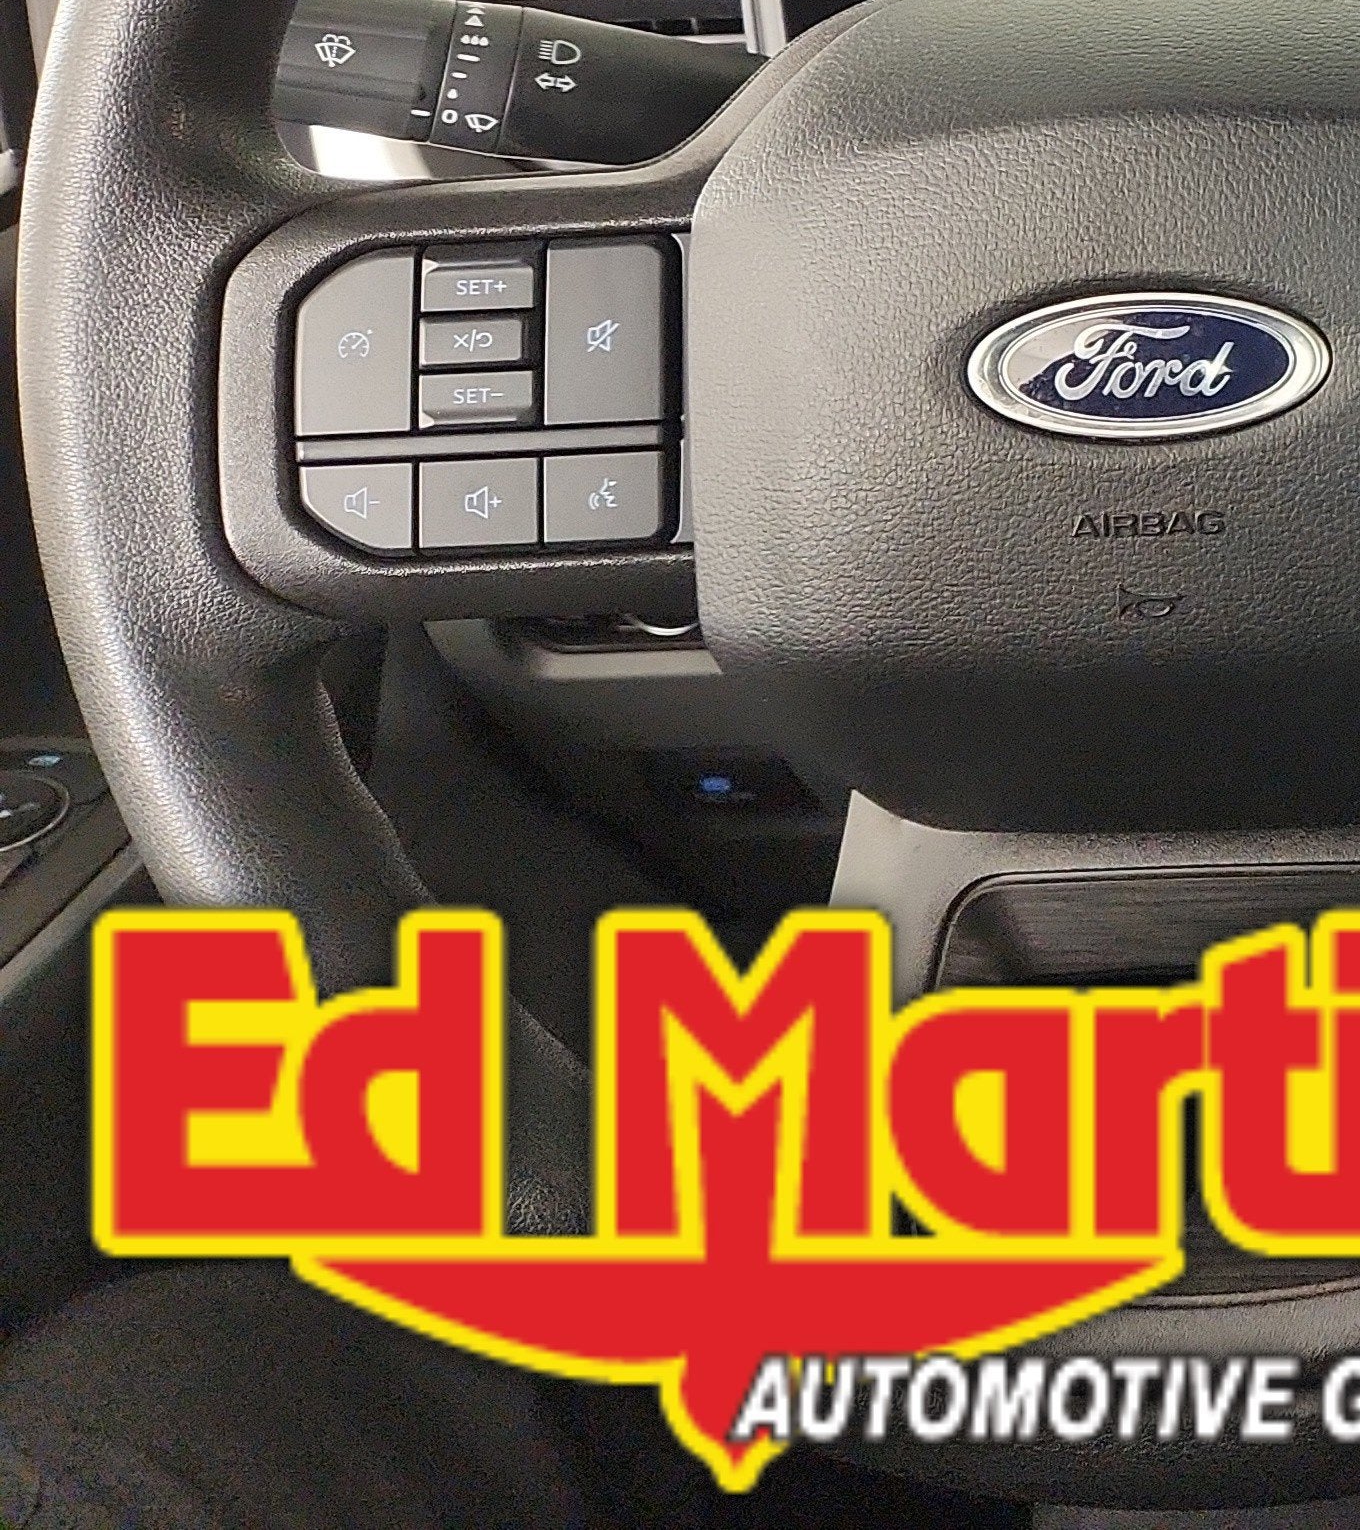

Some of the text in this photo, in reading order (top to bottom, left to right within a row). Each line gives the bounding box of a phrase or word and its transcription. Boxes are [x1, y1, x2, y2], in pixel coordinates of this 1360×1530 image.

[455, 278, 508, 296] SET+
[1053, 322, 1235, 401] Ford
[1070, 510, 1226, 540] AIRBAG
